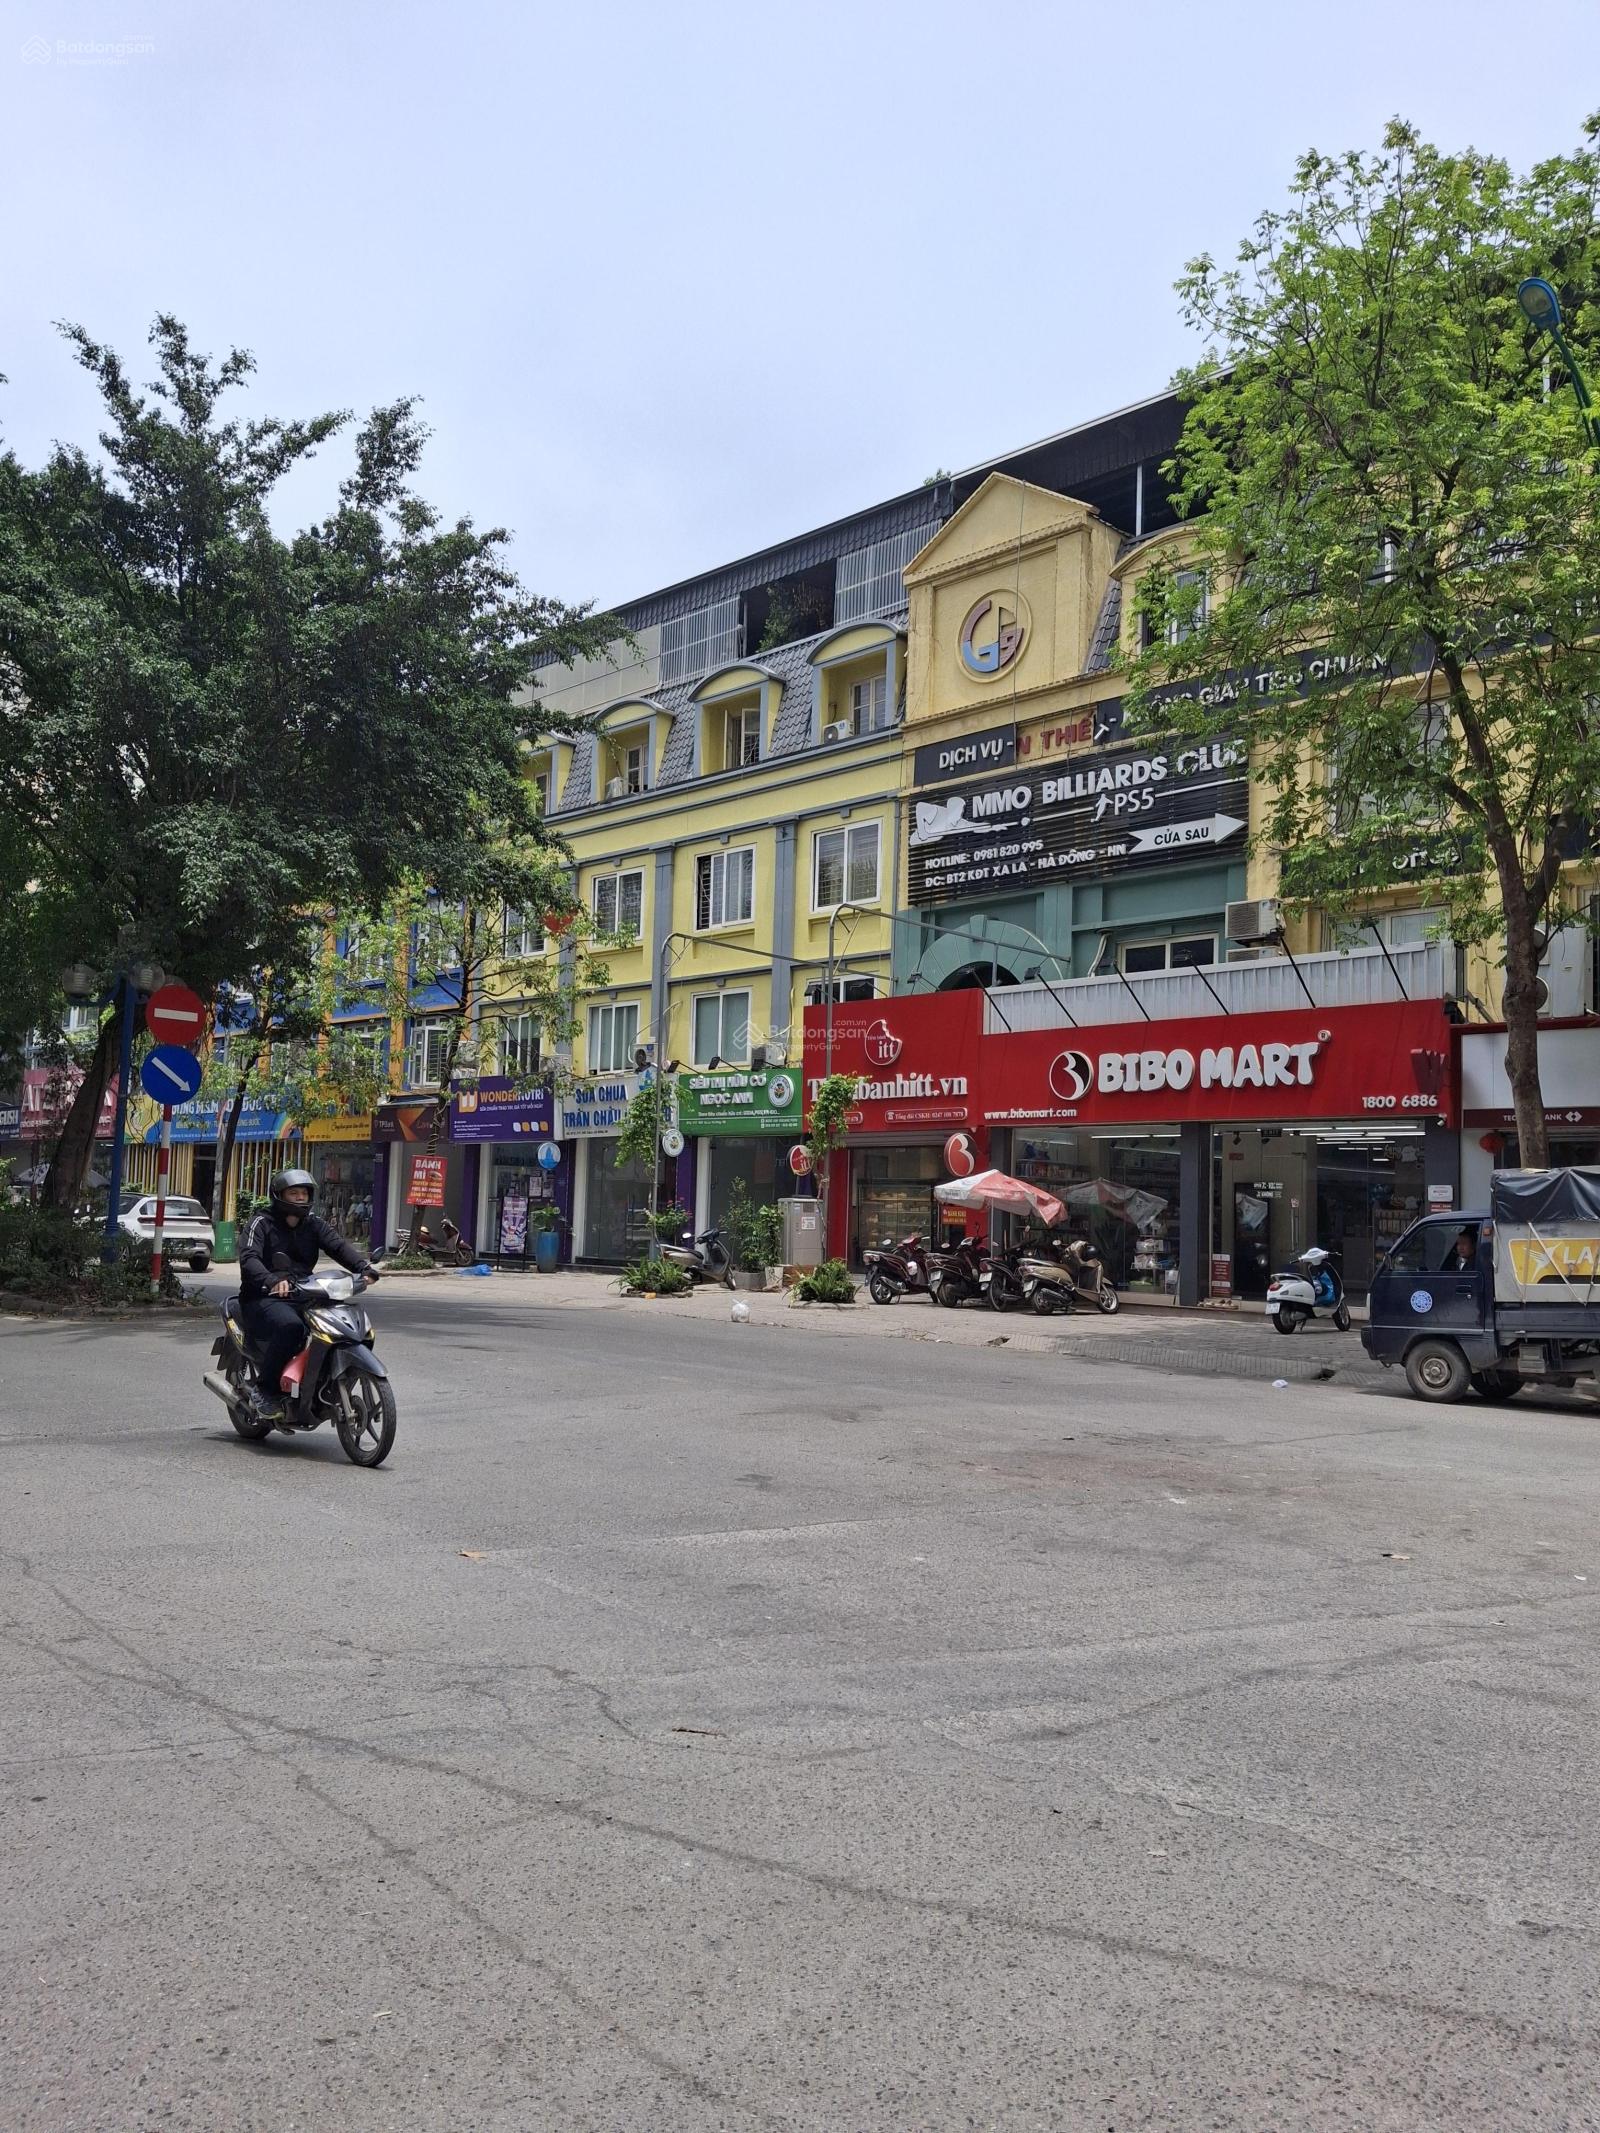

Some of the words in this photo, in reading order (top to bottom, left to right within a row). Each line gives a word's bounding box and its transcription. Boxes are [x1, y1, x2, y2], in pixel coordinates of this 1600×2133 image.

[939, 747, 977, 771] DỊCH
[980, 738, 1003, 761] VỤ
[972, 785, 1032, 819] MMO
[1042, 756, 1168, 805] BILLIARDS
[1114, 787, 1155, 816] PS5
[1154, 822, 1181, 846] CỬA
[1184, 826, 1209, 841] SAU
[925, 853, 971, 869] HOTLINE:
[974, 847, 998, 862] 0981
[999, 844, 1020, 858] 820
[1021, 840, 1044, 853] 995
[946, 872, 966, 885] BT2
[967, 868, 990, 881] KĐT
[992, 864, 1010, 877] XA
[1012, 861, 1028, 874] LA
[1037, 852, 1056, 869] HÀ
[1058, 848, 1096, 866] ĐÔNG
[1107, 844, 1127, 857] HN
[878, 1040, 895, 1059] itt
[1098, 1048, 1195, 1093] BIBO
[1200, 1041, 1320, 1089] MART
[599, 1084, 628, 1102] CHUA
[688, 1075, 710, 1090] SIÊU
[710, 1076, 726, 1091] THỊ
[807, 1072, 969, 1102] Tbanhitt.vn
[700, 1092, 731, 1108] NGỌC
[731, 1091, 754, 1104] ANH
[1362, 1096, 1397, 1109] 1800
[1401, 1094, 1438, 1108] 6886
[563, 1107, 590, 1128] TRÂN
[593, 1105, 621, 1126] CHÂU
[984, 1108, 1078, 1120] www.bibomart.com
[413, 1169, 427, 1180] MÌ
[415, 1158, 442, 1170] BÁNH
